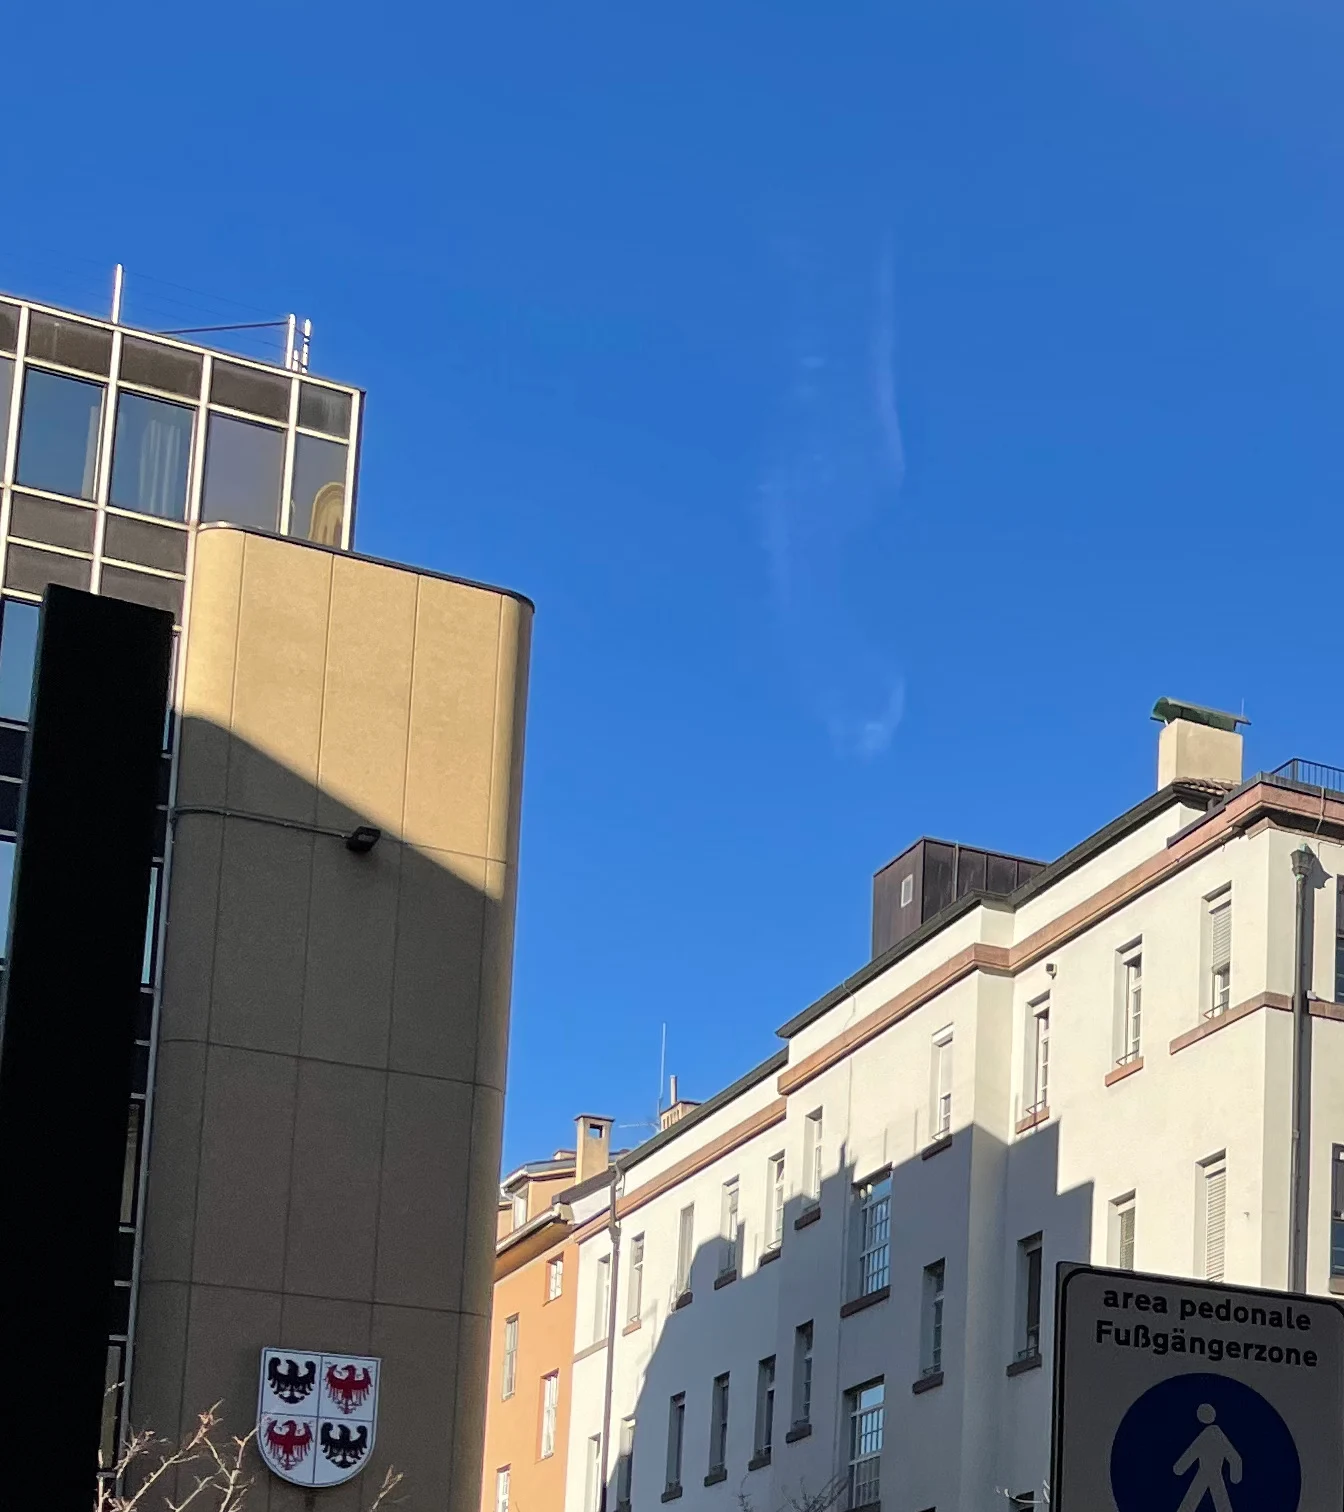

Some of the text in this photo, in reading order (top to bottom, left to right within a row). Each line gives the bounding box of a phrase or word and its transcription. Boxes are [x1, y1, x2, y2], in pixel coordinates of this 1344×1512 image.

[1103, 1289, 1312, 1331] area pedonale
[1095, 1319, 1318, 1367] Fußgängerzone
